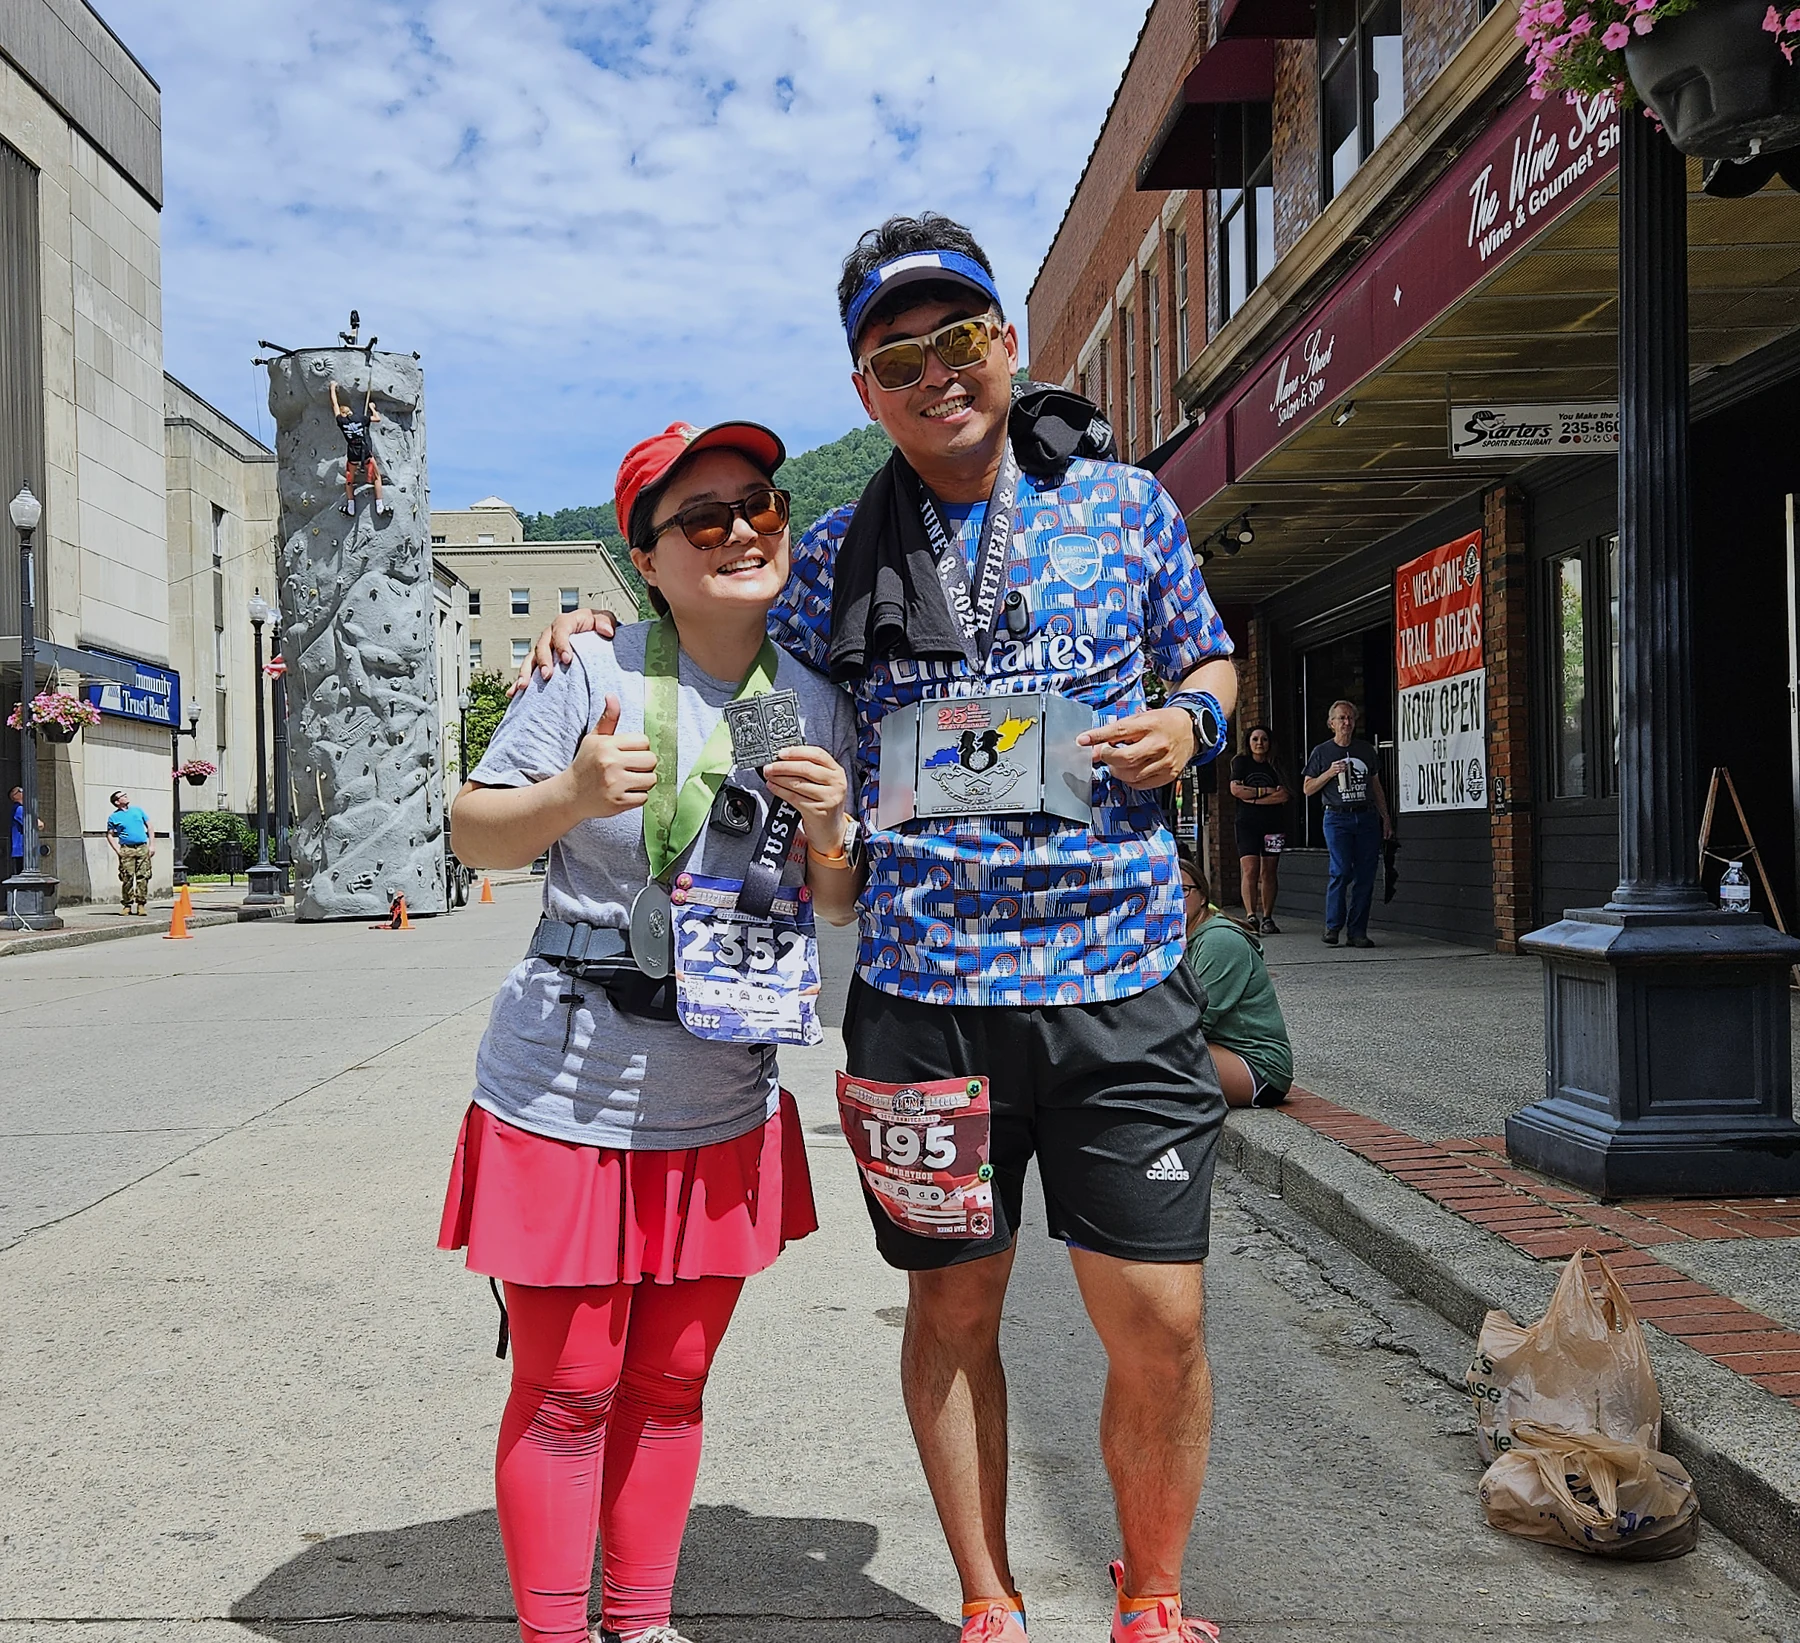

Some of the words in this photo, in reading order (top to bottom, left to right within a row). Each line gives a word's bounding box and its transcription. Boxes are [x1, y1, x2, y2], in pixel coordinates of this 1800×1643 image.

[1467, 163, 1500, 248] The
[1508, 114, 1560, 212] Wine
[1478, 220, 1513, 262] Wine
[1515, 203, 1526, 229] &
[1528, 143, 1594, 216] Gourmet
[1597, 122, 1620, 158] Sh
[1300, 328, 1335, 384] Street
[1278, 397, 1301, 427] Salon
[1300, 387, 1308, 408] &
[1308, 377, 1326, 406] Spa
[1562, 420, 1620, 434] 235-860
[1575, 412, 1598, 420] Make
[1600, 411, 1614, 419] the
[1482, 439, 1509, 448] SPORTS
[1509, 437, 1553, 447] RESTAURANT
[919, 498, 949, 555] JUNE
[939, 556, 957, 580] 8,
[948, 580, 978, 639] 2024
[976, 513, 1010, 633] HATFIELD
[999, 487, 1014, 509] &
[1412, 555, 1463, 608] WELCOME
[889, 630, 1097, 684] Emrates
[1400, 622, 1432, 669] TRAIL
[1435, 602, 1480, 659] RIDERS
[122, 690, 148, 716] Trust
[148, 695, 170, 720] Bank
[135, 673, 172, 702] mmunity
[1402, 685, 1435, 742] NOW
[1440, 677, 1480, 735] OPEN
[1432, 739, 1448, 760] FOR
[1338, 783, 1366, 792] FOOT
[1418, 762, 1447, 805] DINE
[1451, 759, 1464, 804] IN
[759, 801, 799, 876] JUST
[681, 919, 810, 972] 2352
[862, 1119, 957, 1170] 195
[1146, 1168, 1190, 1181] adidas
